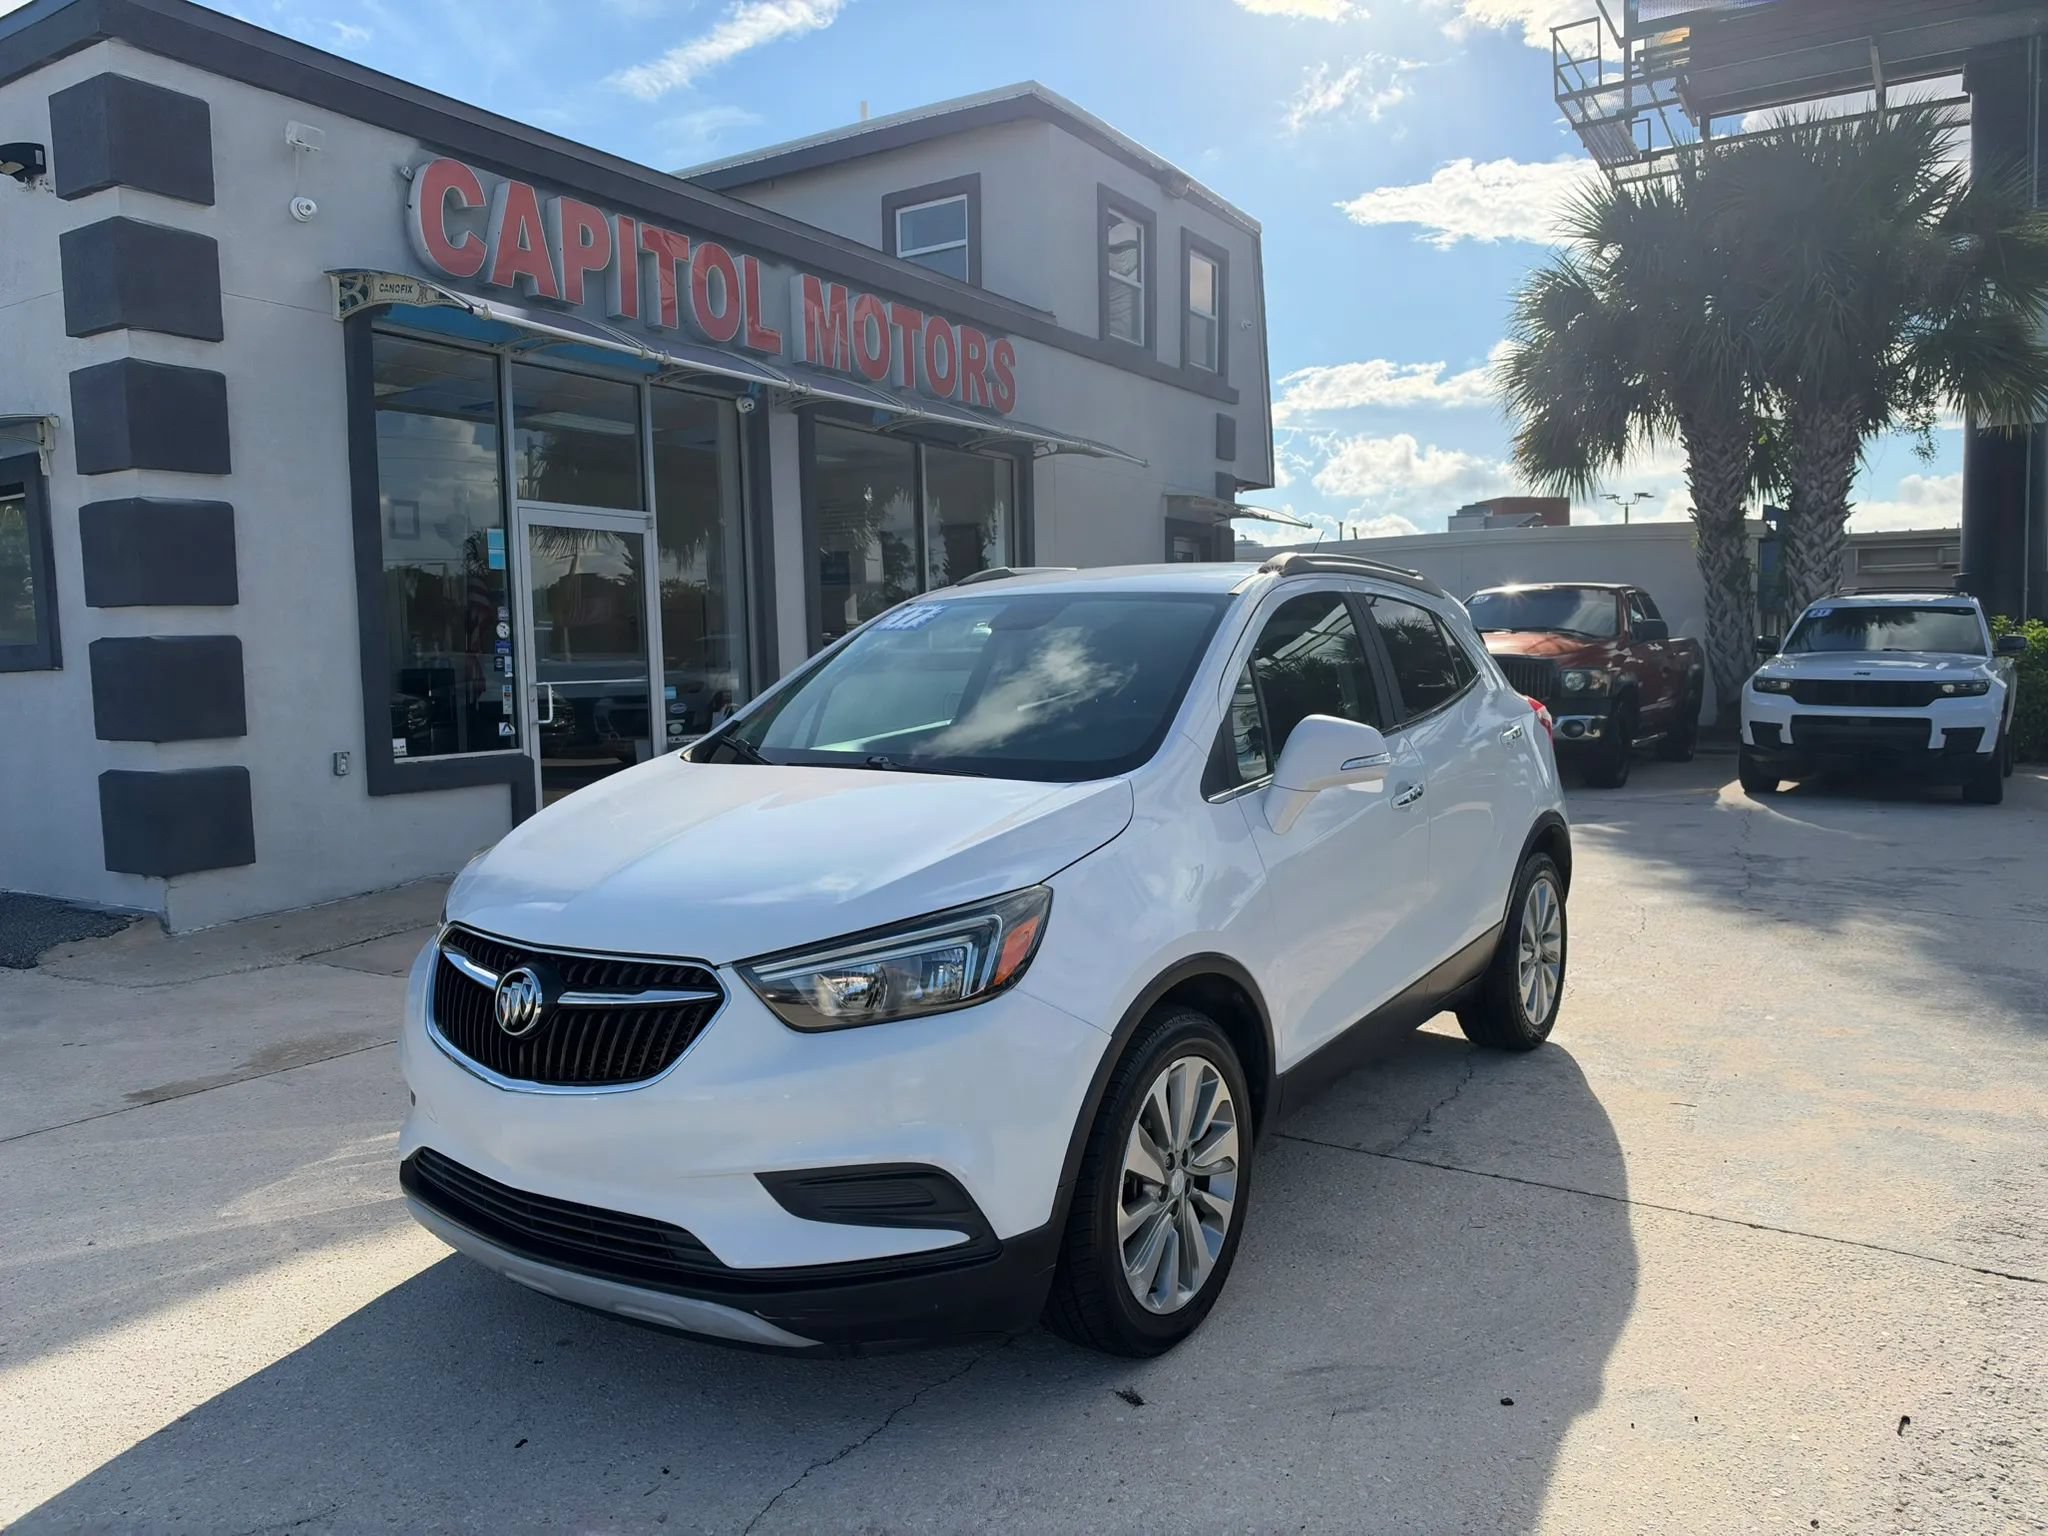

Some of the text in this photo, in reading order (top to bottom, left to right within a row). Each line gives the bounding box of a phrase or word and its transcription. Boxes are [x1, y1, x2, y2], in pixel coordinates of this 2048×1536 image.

[378, 282, 414, 295] CANOFIX
[414, 157, 1018, 416] CAPITOL MOTORS
